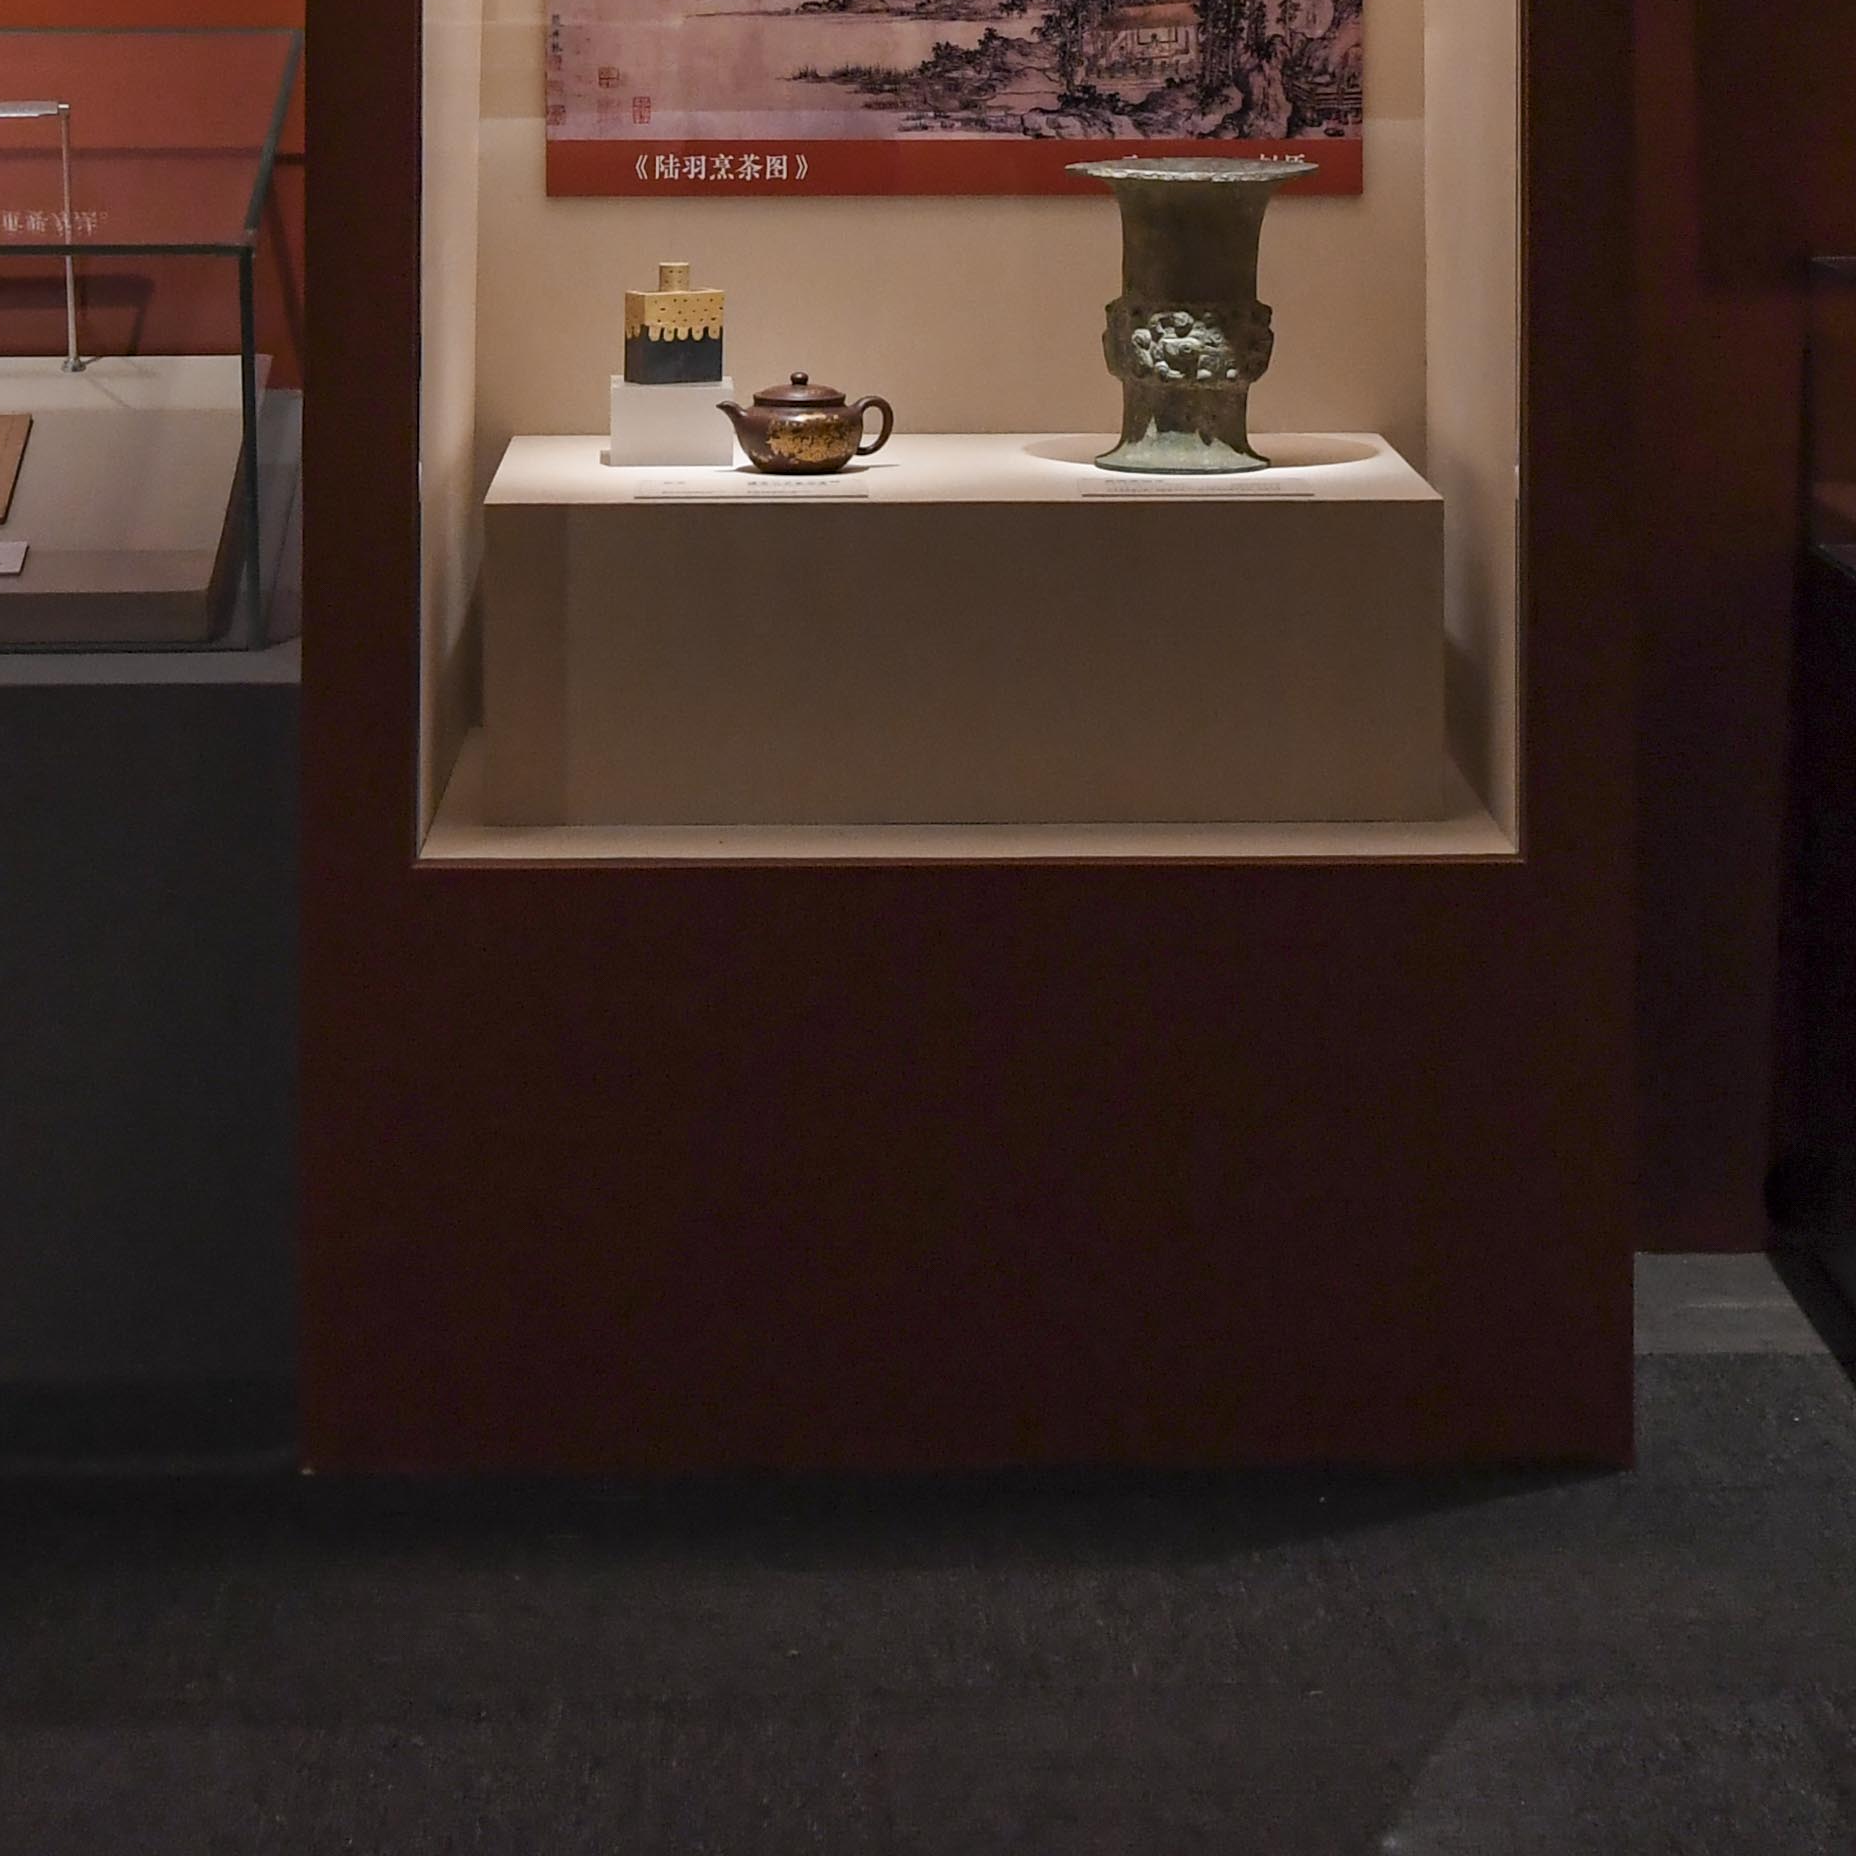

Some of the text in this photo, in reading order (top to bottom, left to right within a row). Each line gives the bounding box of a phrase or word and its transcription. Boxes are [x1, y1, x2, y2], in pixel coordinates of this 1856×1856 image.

[634, 152, 810, 182] 《陆羽烹茶图》
